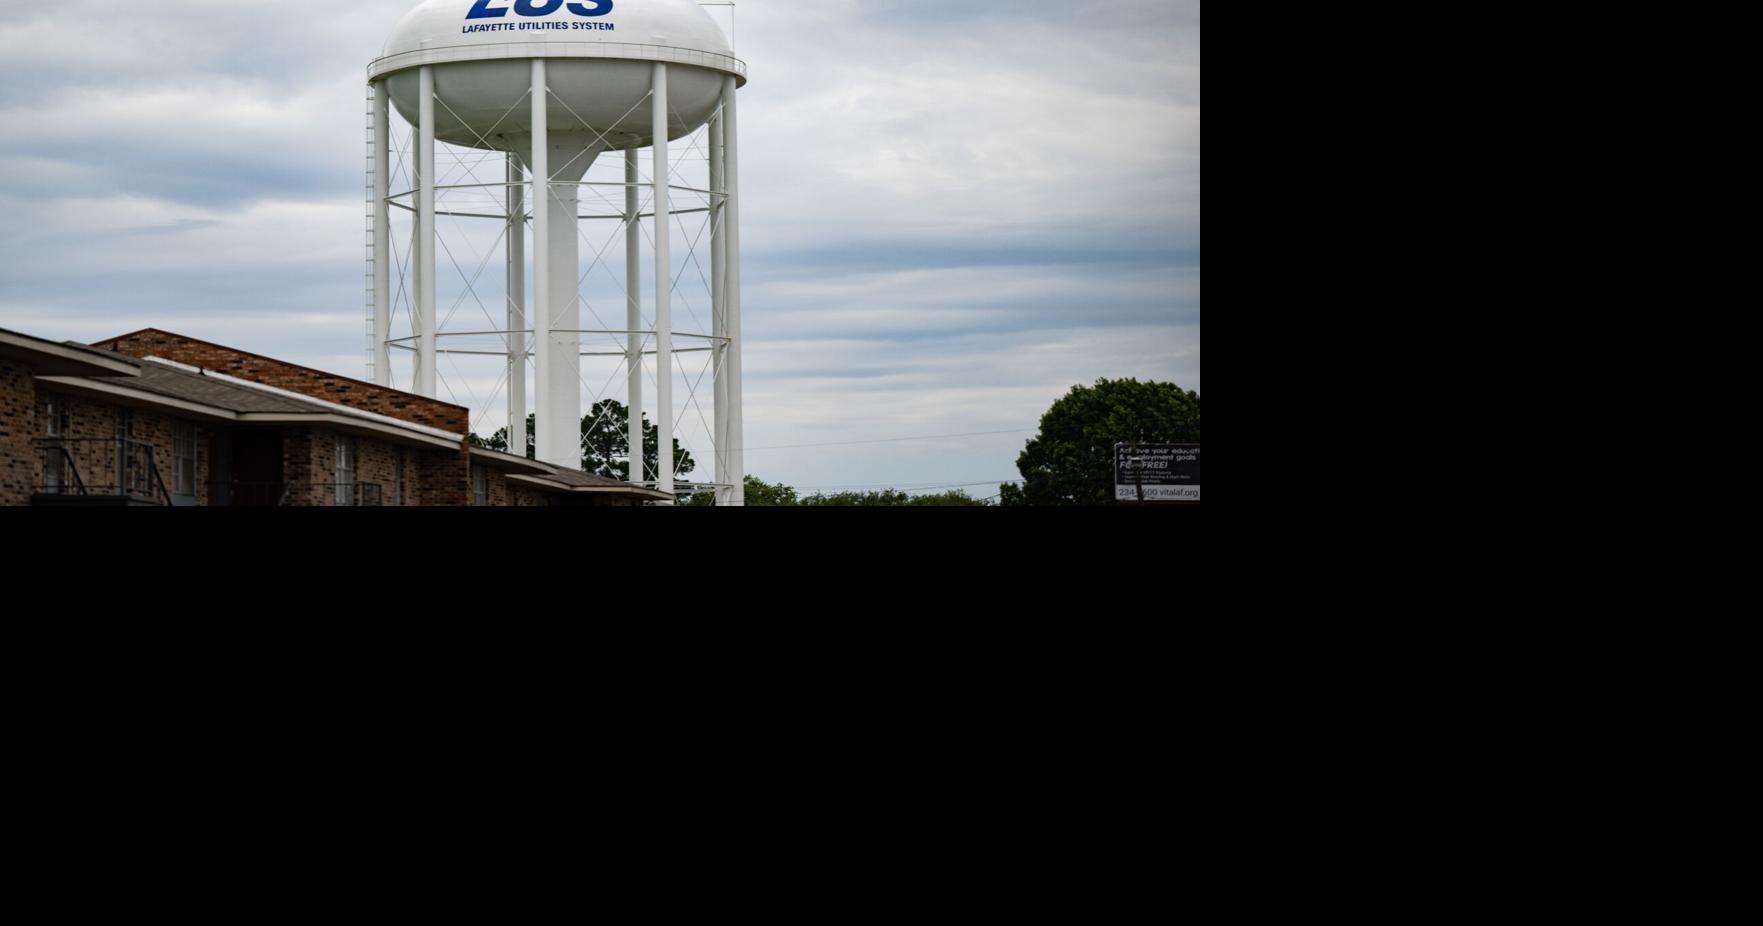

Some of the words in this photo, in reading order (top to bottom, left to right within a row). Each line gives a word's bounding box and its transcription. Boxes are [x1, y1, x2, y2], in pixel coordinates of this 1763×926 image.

[462, 22, 515, 33] LAFAYETTE
[518, 21, 569, 31] UTILITIES
[572, 21, 614, 31] SYSTEM
[1160, 488, 1199, 498] vitalaf.org
